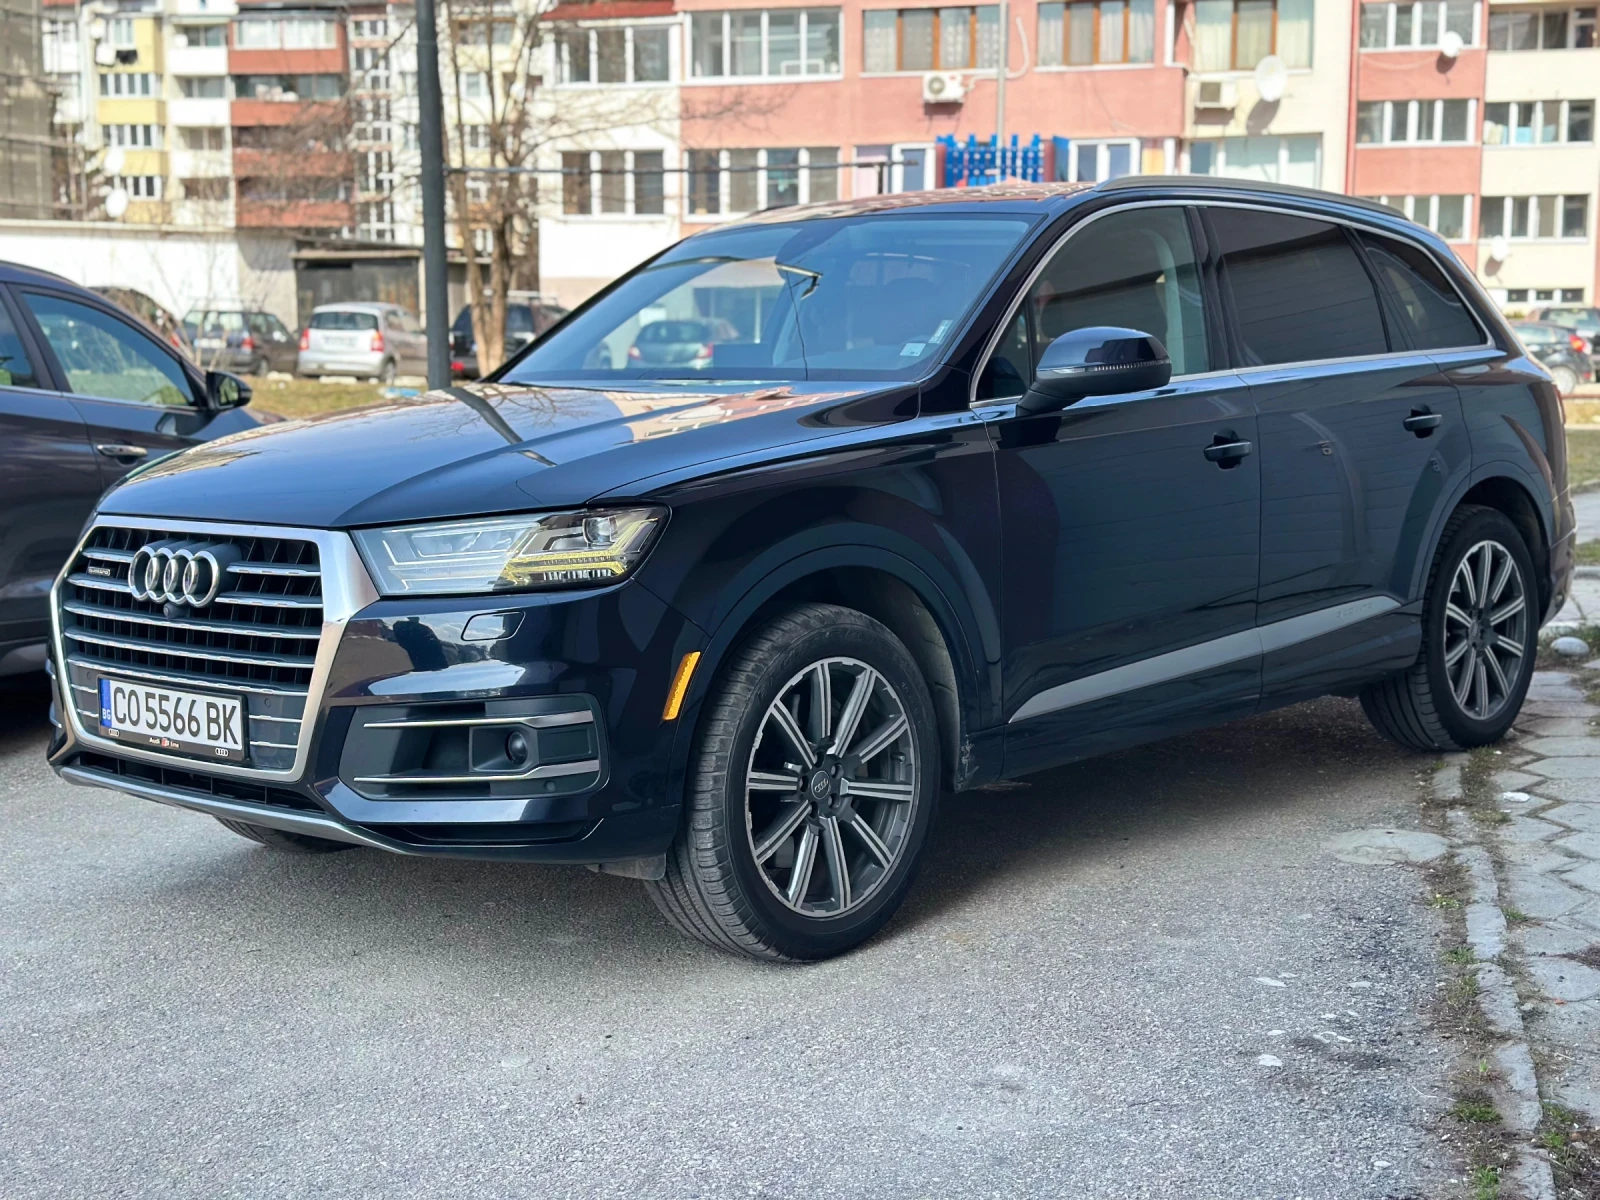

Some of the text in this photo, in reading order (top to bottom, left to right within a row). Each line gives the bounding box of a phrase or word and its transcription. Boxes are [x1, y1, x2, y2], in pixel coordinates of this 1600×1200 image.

[102, 708, 112, 720] BG
[113, 686, 239, 745] CO 5566 BK
